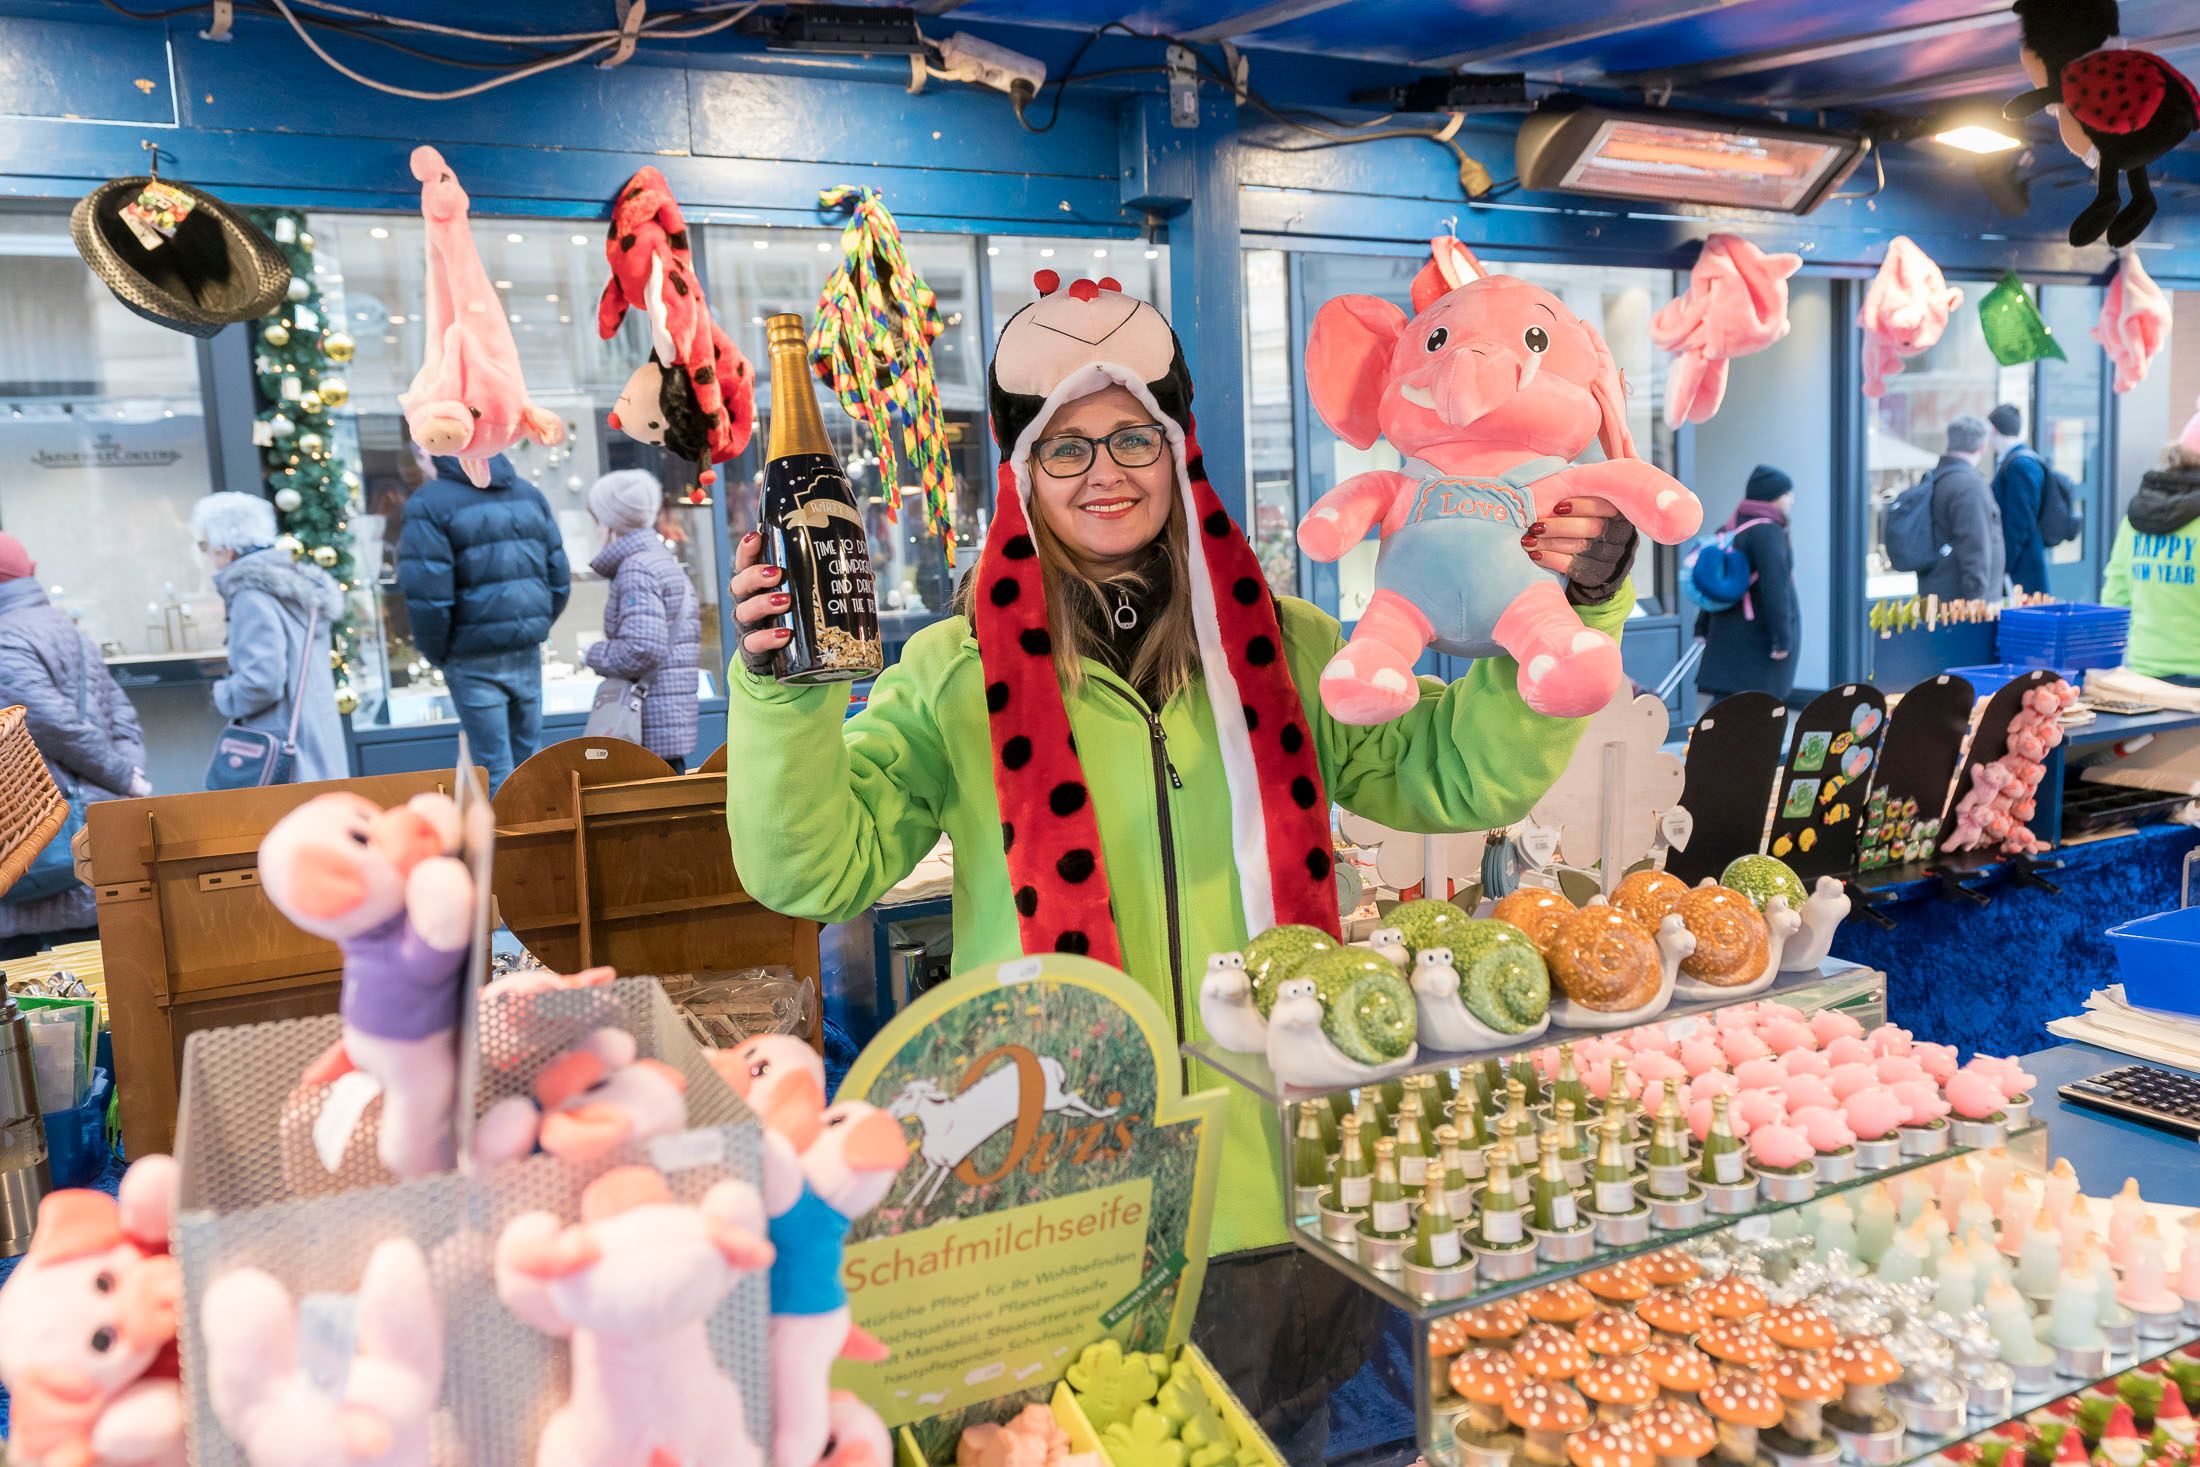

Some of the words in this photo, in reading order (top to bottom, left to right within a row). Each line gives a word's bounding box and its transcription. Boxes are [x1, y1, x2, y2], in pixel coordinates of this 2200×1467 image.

[1439, 492, 1508, 521] Love
[813, 539, 837, 560] TIME
[839, 539, 854, 554] TO
[856, 539, 867, 554] DR
[2134, 532, 2198, 561] HAPPY
[830, 579, 853, 595] AND
[2157, 564, 2195, 585] YEAR
[827, 598, 848, 615] ON
[851, 598, 866, 613] THE
[845, 1194, 1144, 1294] Schafmilchseife
[931, 1290, 981, 1312] Pflege
[985, 1283, 1007, 1298] für
[1035, 1252, 1137, 1285] Wohlbefinden
